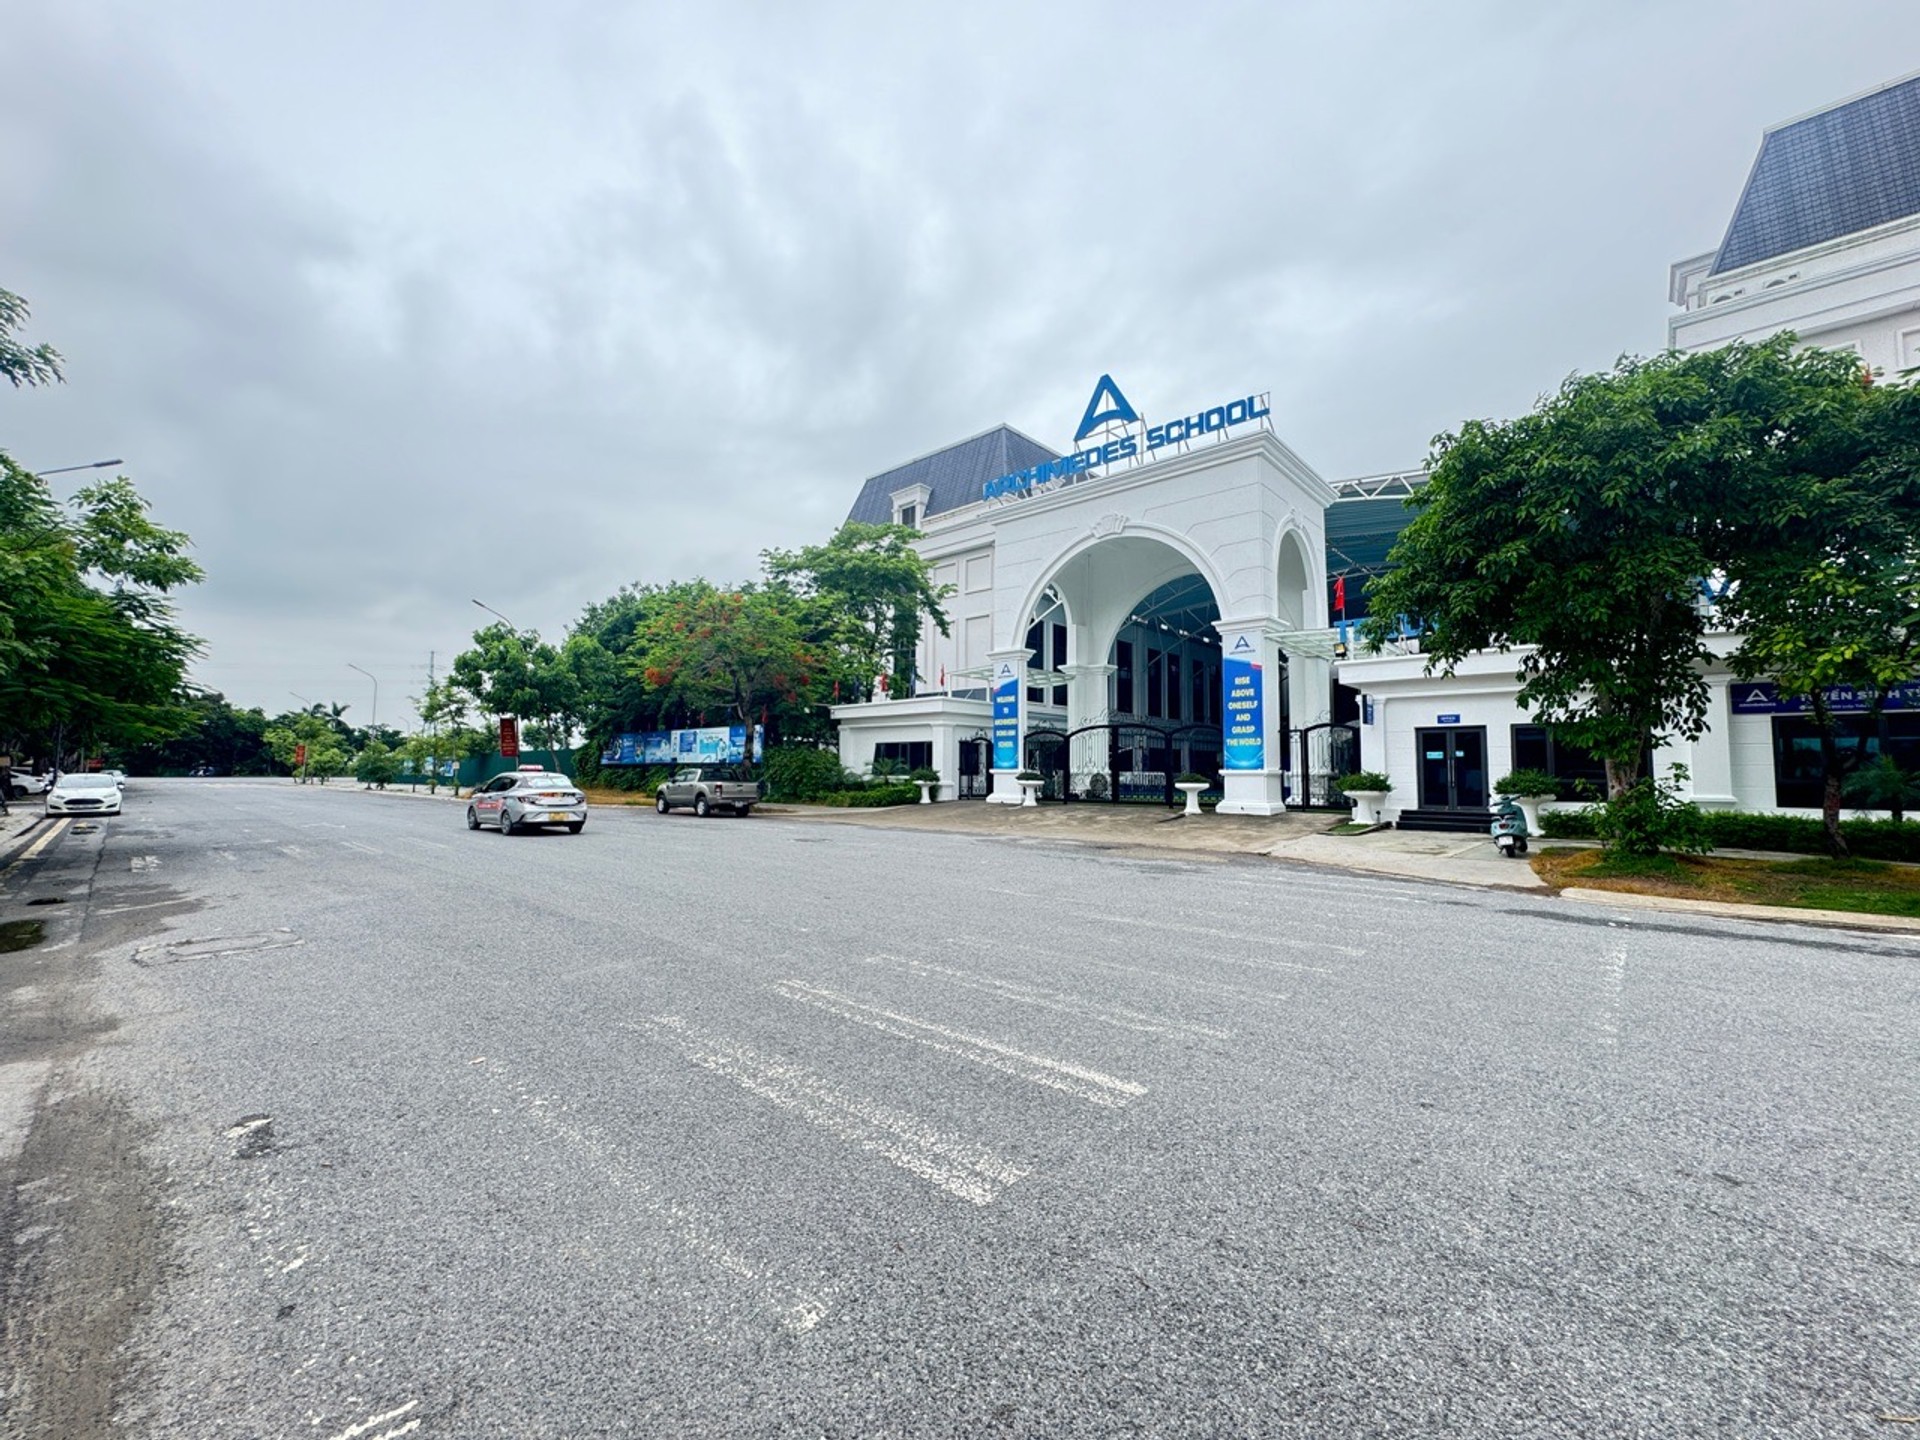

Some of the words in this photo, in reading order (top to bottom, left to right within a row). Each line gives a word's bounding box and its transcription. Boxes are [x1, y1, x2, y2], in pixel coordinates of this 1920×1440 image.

[982, 435, 1137, 500] ARCHIMEDES
[1146, 396, 1270, 450] SCHOOL
[1231, 688, 1254, 698] ABOVE
[1228, 700, 1258, 711] ONESELF
[1235, 712, 1251, 721] AND
[1231, 726, 1255, 735] GRASP
